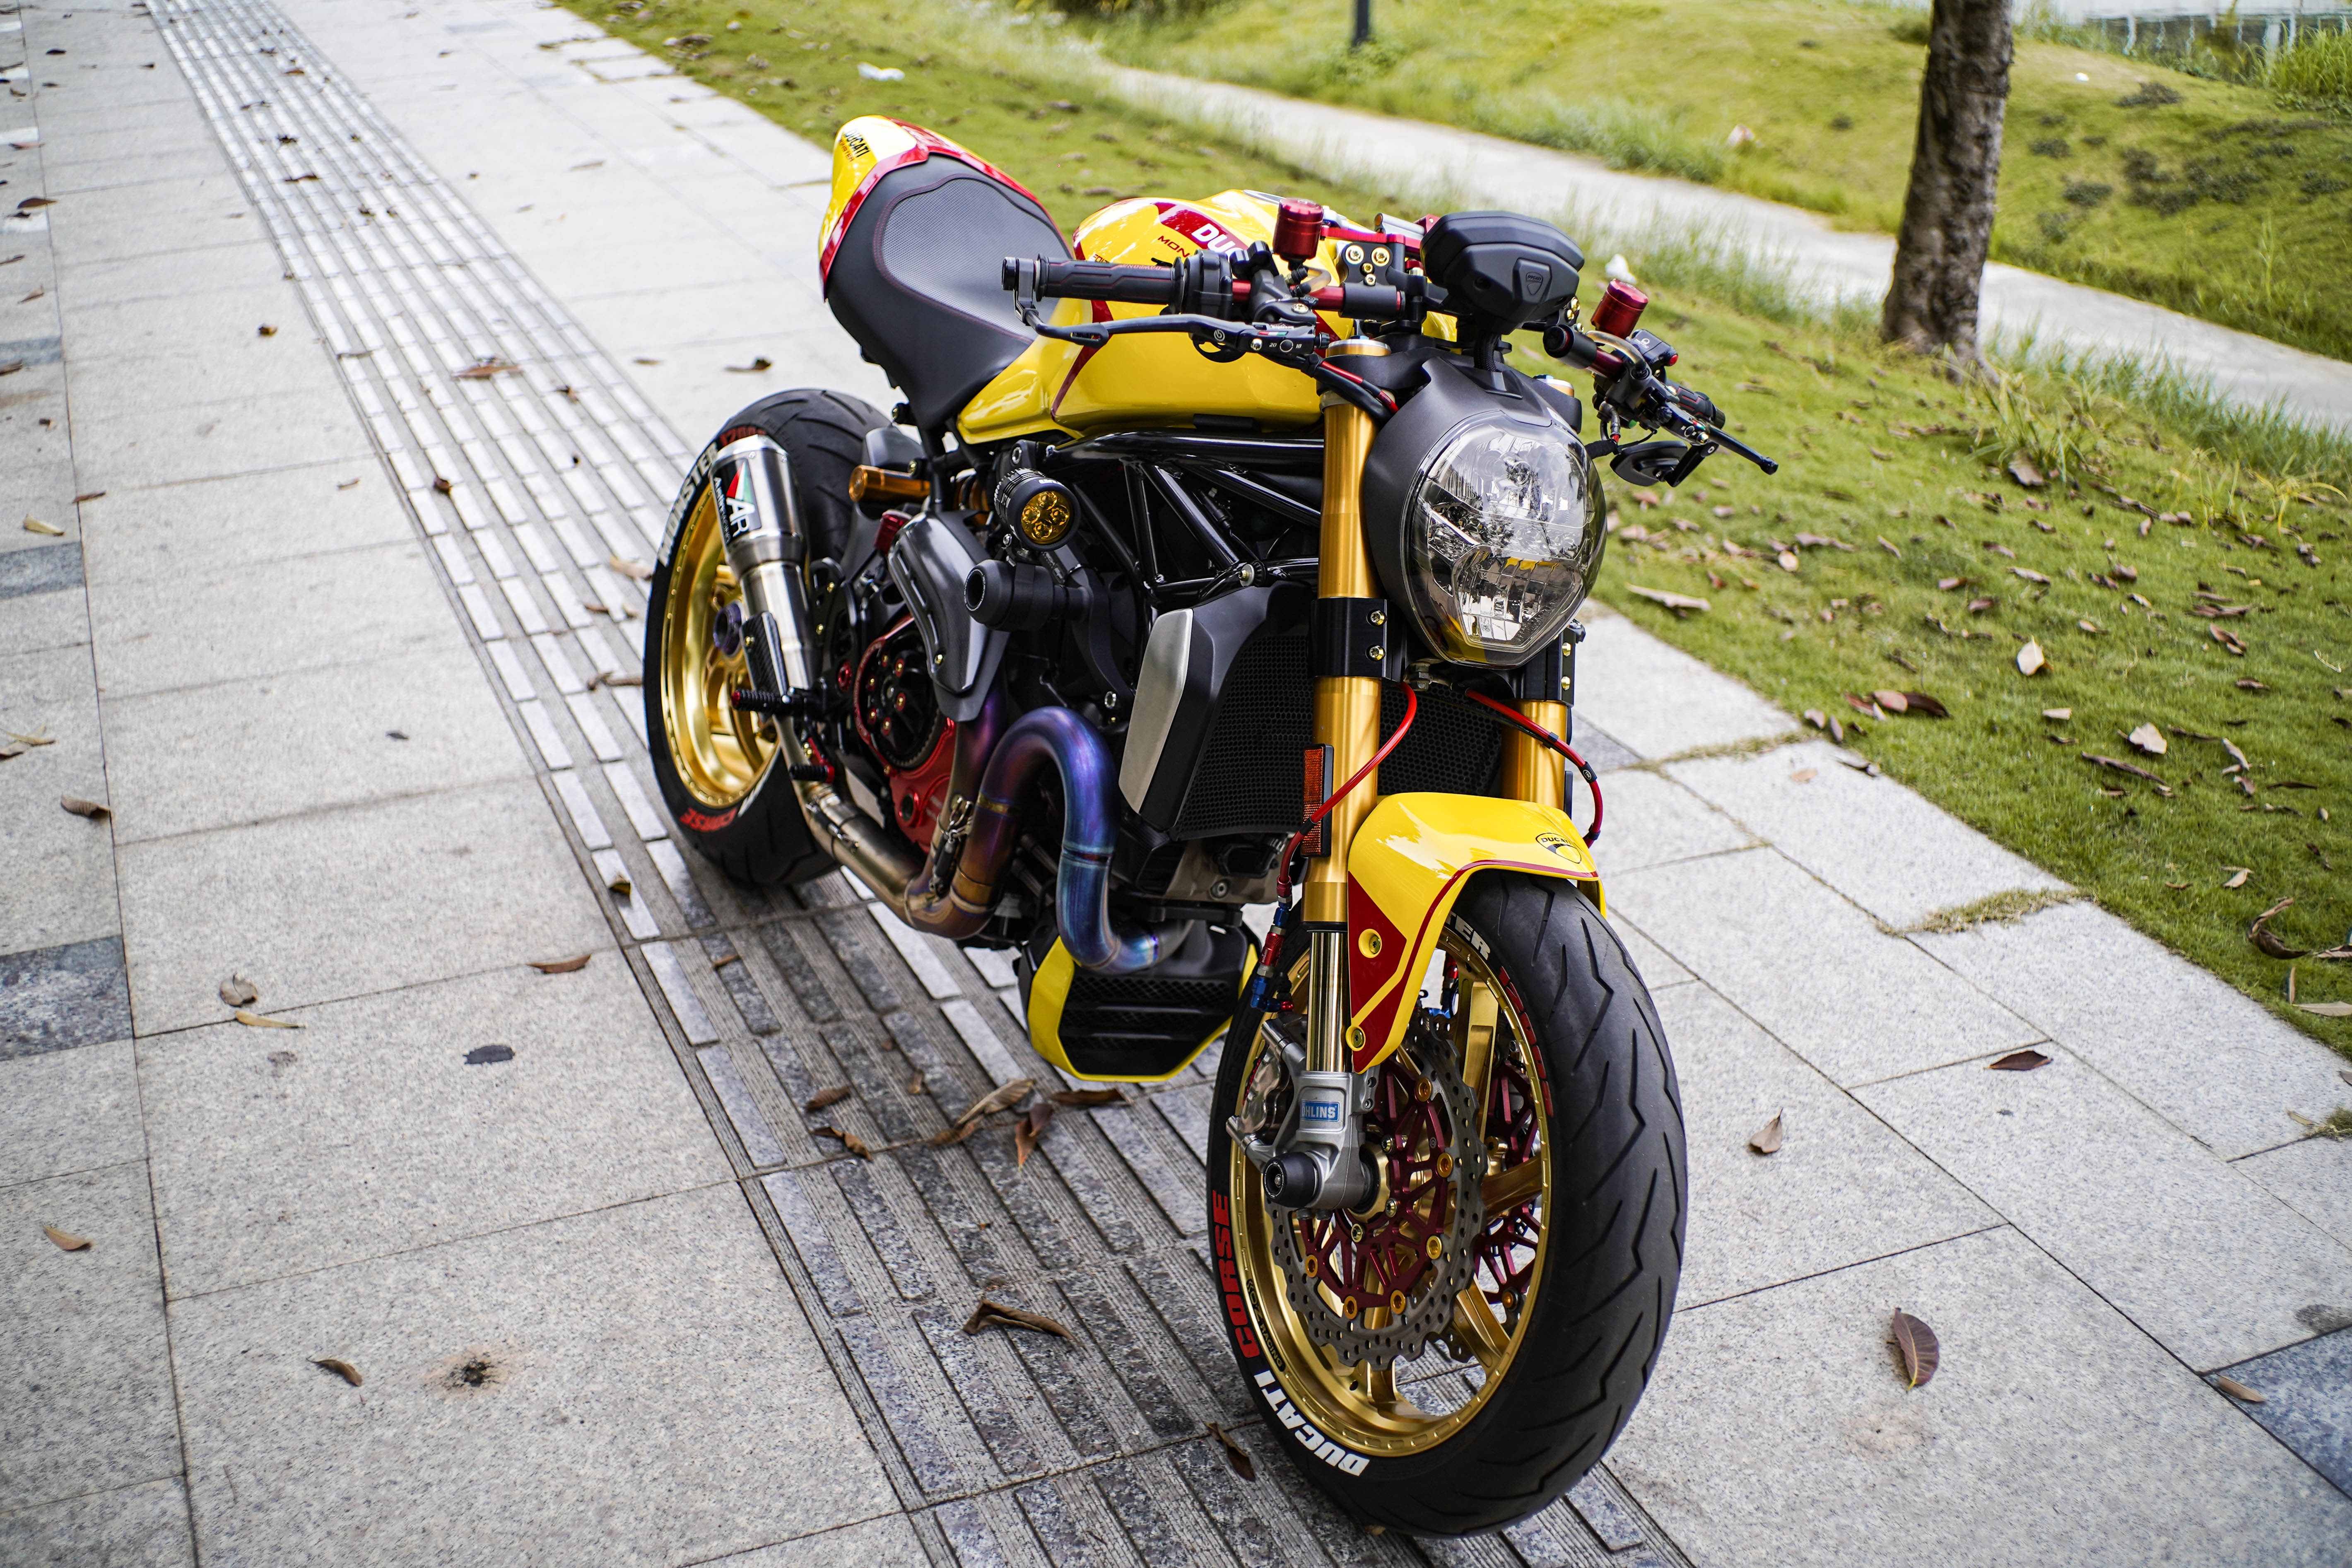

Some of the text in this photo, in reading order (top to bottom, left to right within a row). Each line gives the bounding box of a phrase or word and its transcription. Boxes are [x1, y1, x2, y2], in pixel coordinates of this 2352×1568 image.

[726, 497, 755, 537] AR
[1212, 1190, 1370, 1477] DUCATI CORSE
[1260, 1323, 1283, 1367] RACING
